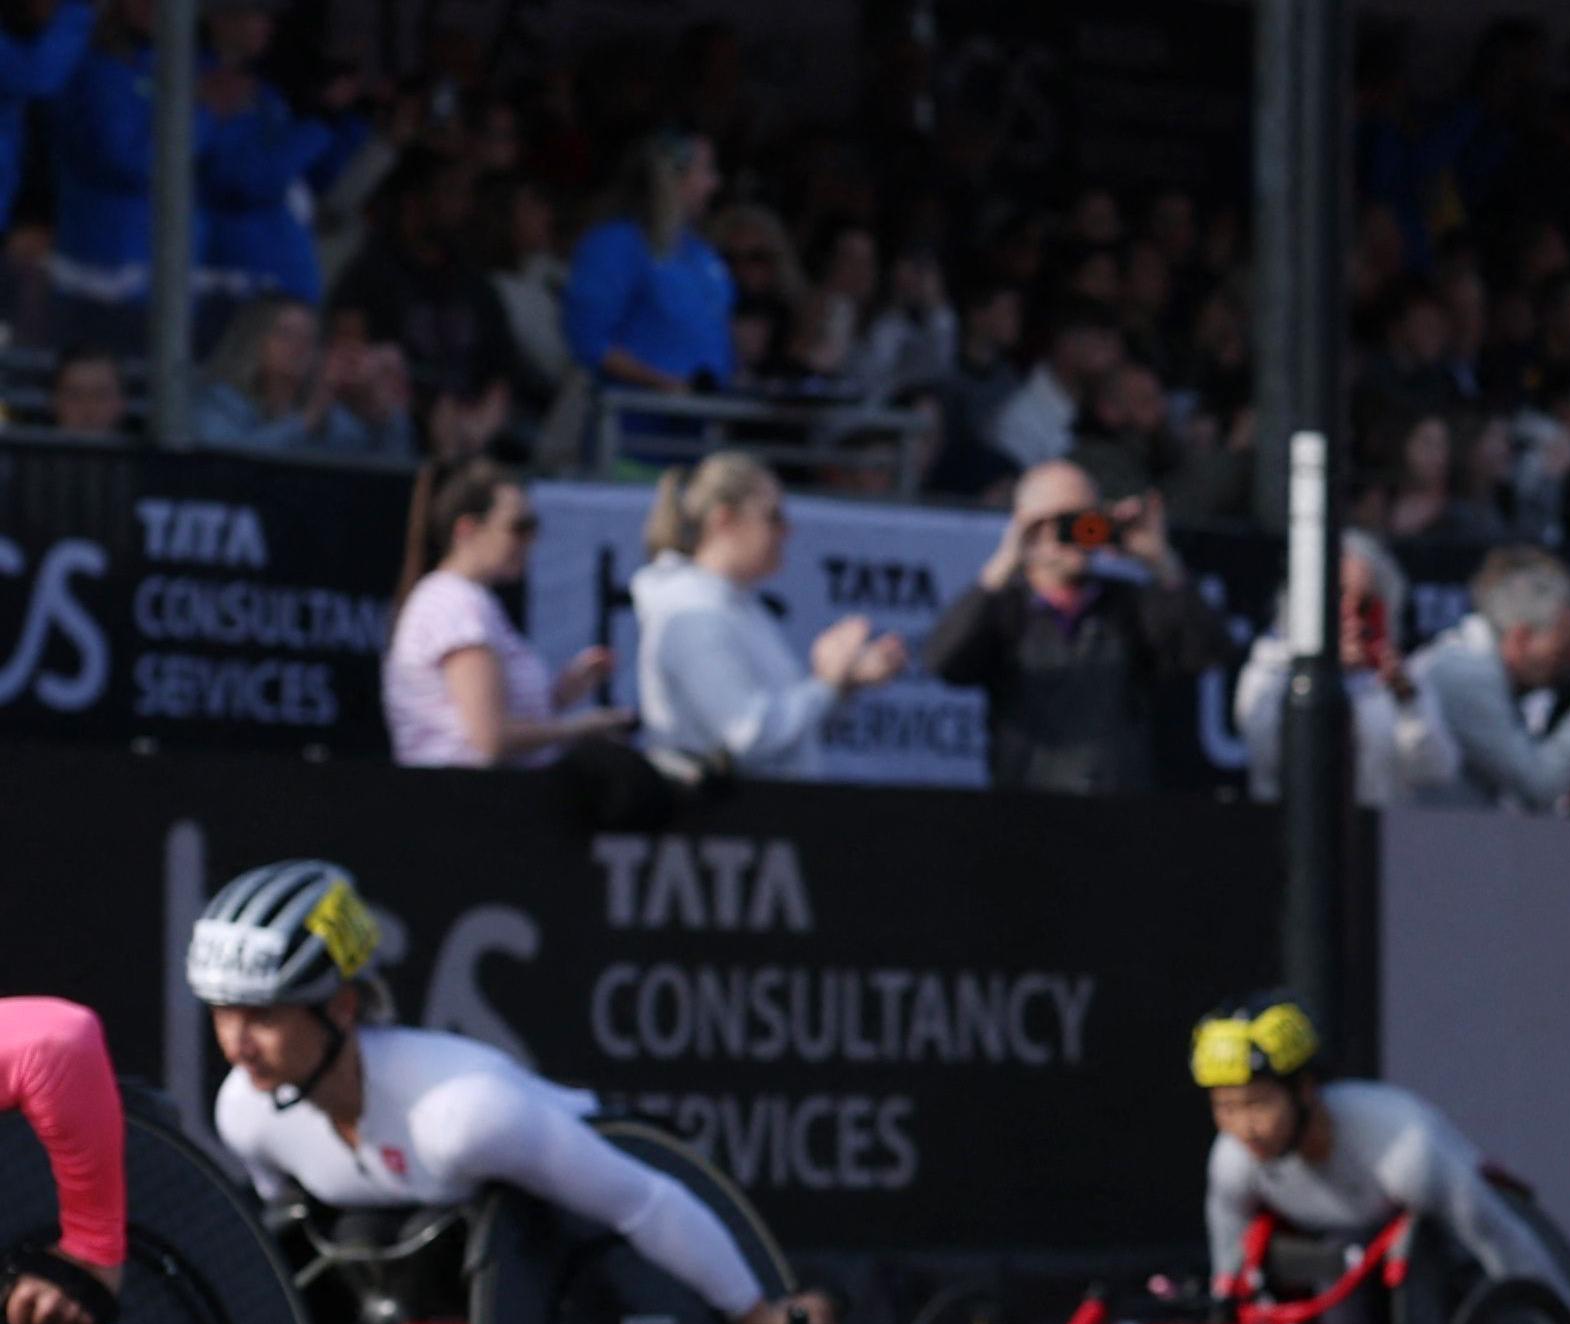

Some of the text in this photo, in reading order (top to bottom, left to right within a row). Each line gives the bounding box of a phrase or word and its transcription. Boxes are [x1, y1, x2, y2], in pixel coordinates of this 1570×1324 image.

[133, 498, 272, 568] TATA
[822, 557, 938, 609] TATA
[590, 831, 816, 934] TATA
[589, 960, 1097, 1068] CONSULTANCY
[610, 1092, 921, 1191] RVICES
